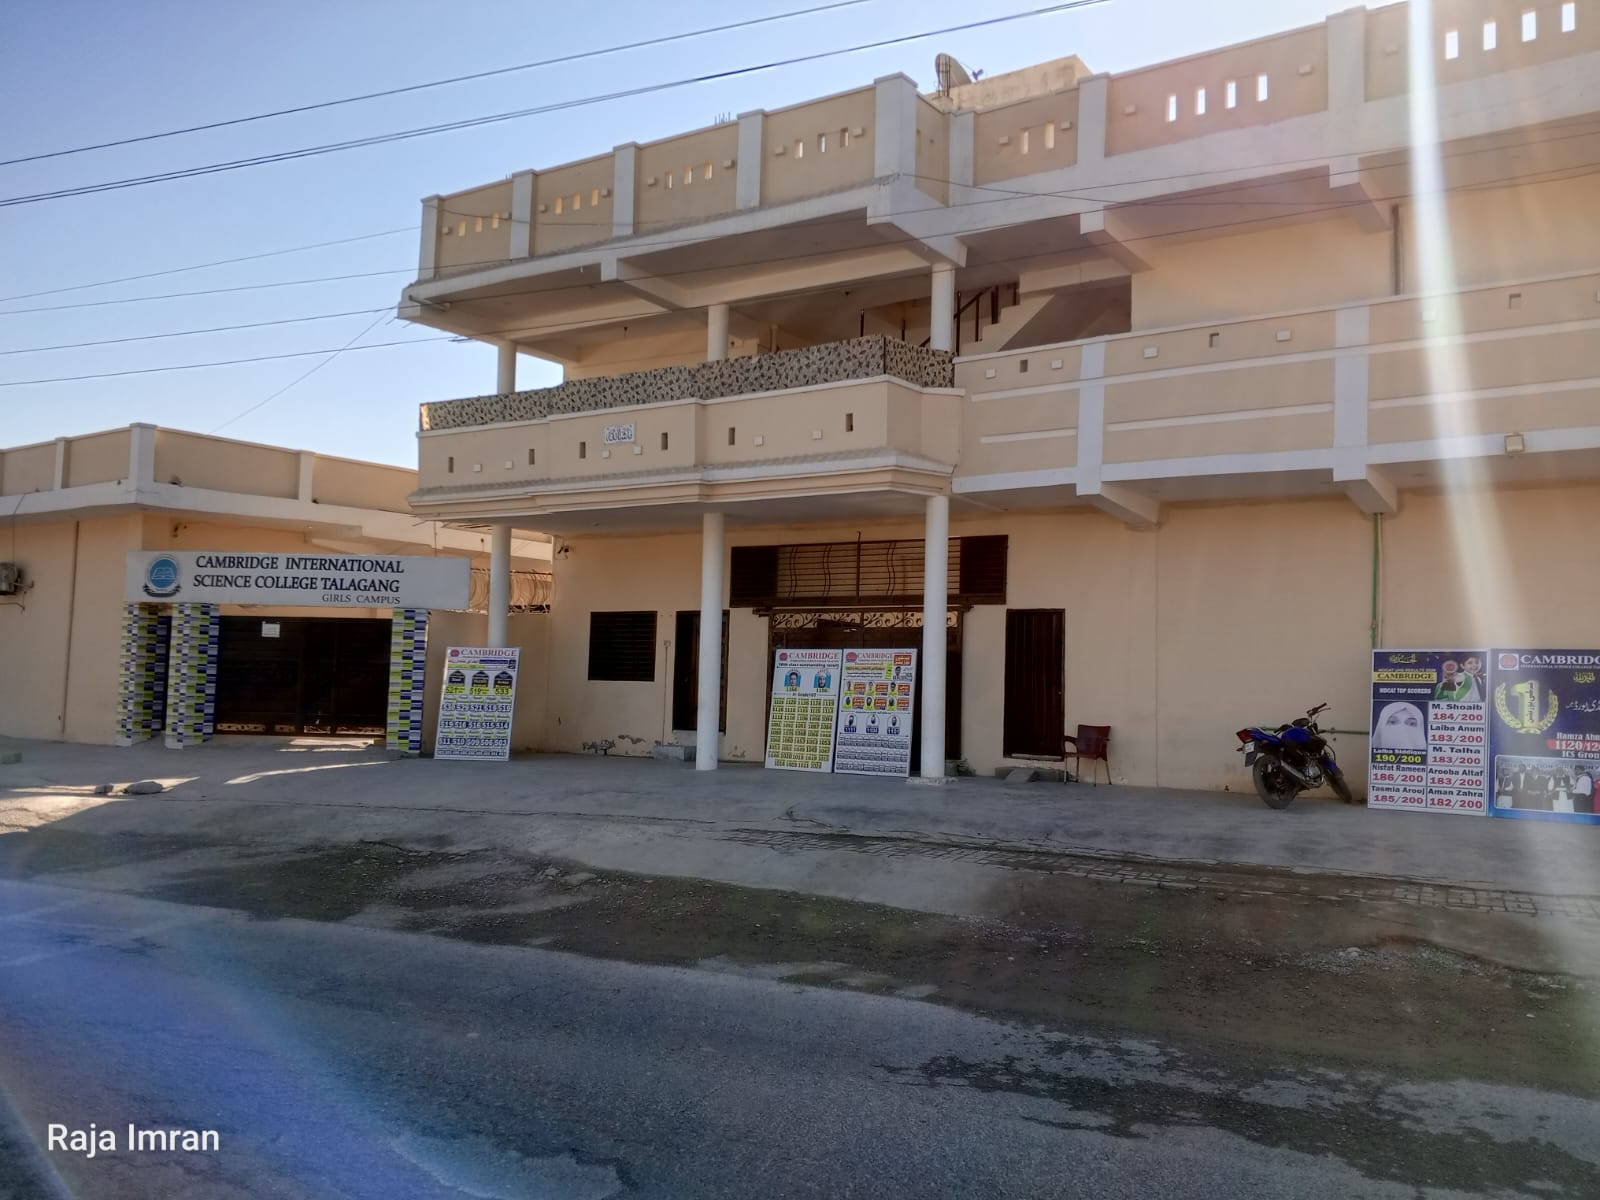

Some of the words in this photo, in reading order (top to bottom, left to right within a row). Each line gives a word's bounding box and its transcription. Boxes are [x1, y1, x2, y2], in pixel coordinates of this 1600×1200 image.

[196, 556, 279, 570] CAMBRIDGE
[285, 557, 404, 573] INTERNATIONAL
[193, 575, 251, 588] SCIENCE
[254, 576, 318, 590] COLLEGE
[320, 578, 400, 593] TALAGANG
[322, 593, 351, 603] GIRLS
[356, 594, 401, 605] CAMPUS
[461, 649, 517, 657] CAMBRIDGE
[789, 652, 840, 660] CAMBRIDGE
[1446, 703, 1483, 711] Shoaib
[1433, 713, 1483, 721] 184/200
[1430, 724, 1456, 732] Laiba
[1457, 725, 1485, 733] Anum
[1430, 734, 1483, 743] 183/200
[1556, 731, 1583, 740] Hamza
[1375, 754, 1421, 763] 190/200
[1431, 756, 1481, 765] 183/200
[1395, 765, 1426, 773] Rameen
[1428, 768, 1460, 776] Arooba
[1461, 769, 1484, 777] Altaf
[1372, 773, 1424, 783] 186/200
[1429, 777, 1482, 787] 183/200
[1371, 785, 1400, 793] Tasmia
[1402, 787, 1425, 796] Arooj
[1428, 788, 1454, 796] Aman
[1455, 789, 1483, 798] Zahra
[1373, 795, 1424, 804] 185/200
[1429, 798, 1483, 809] 182/200
